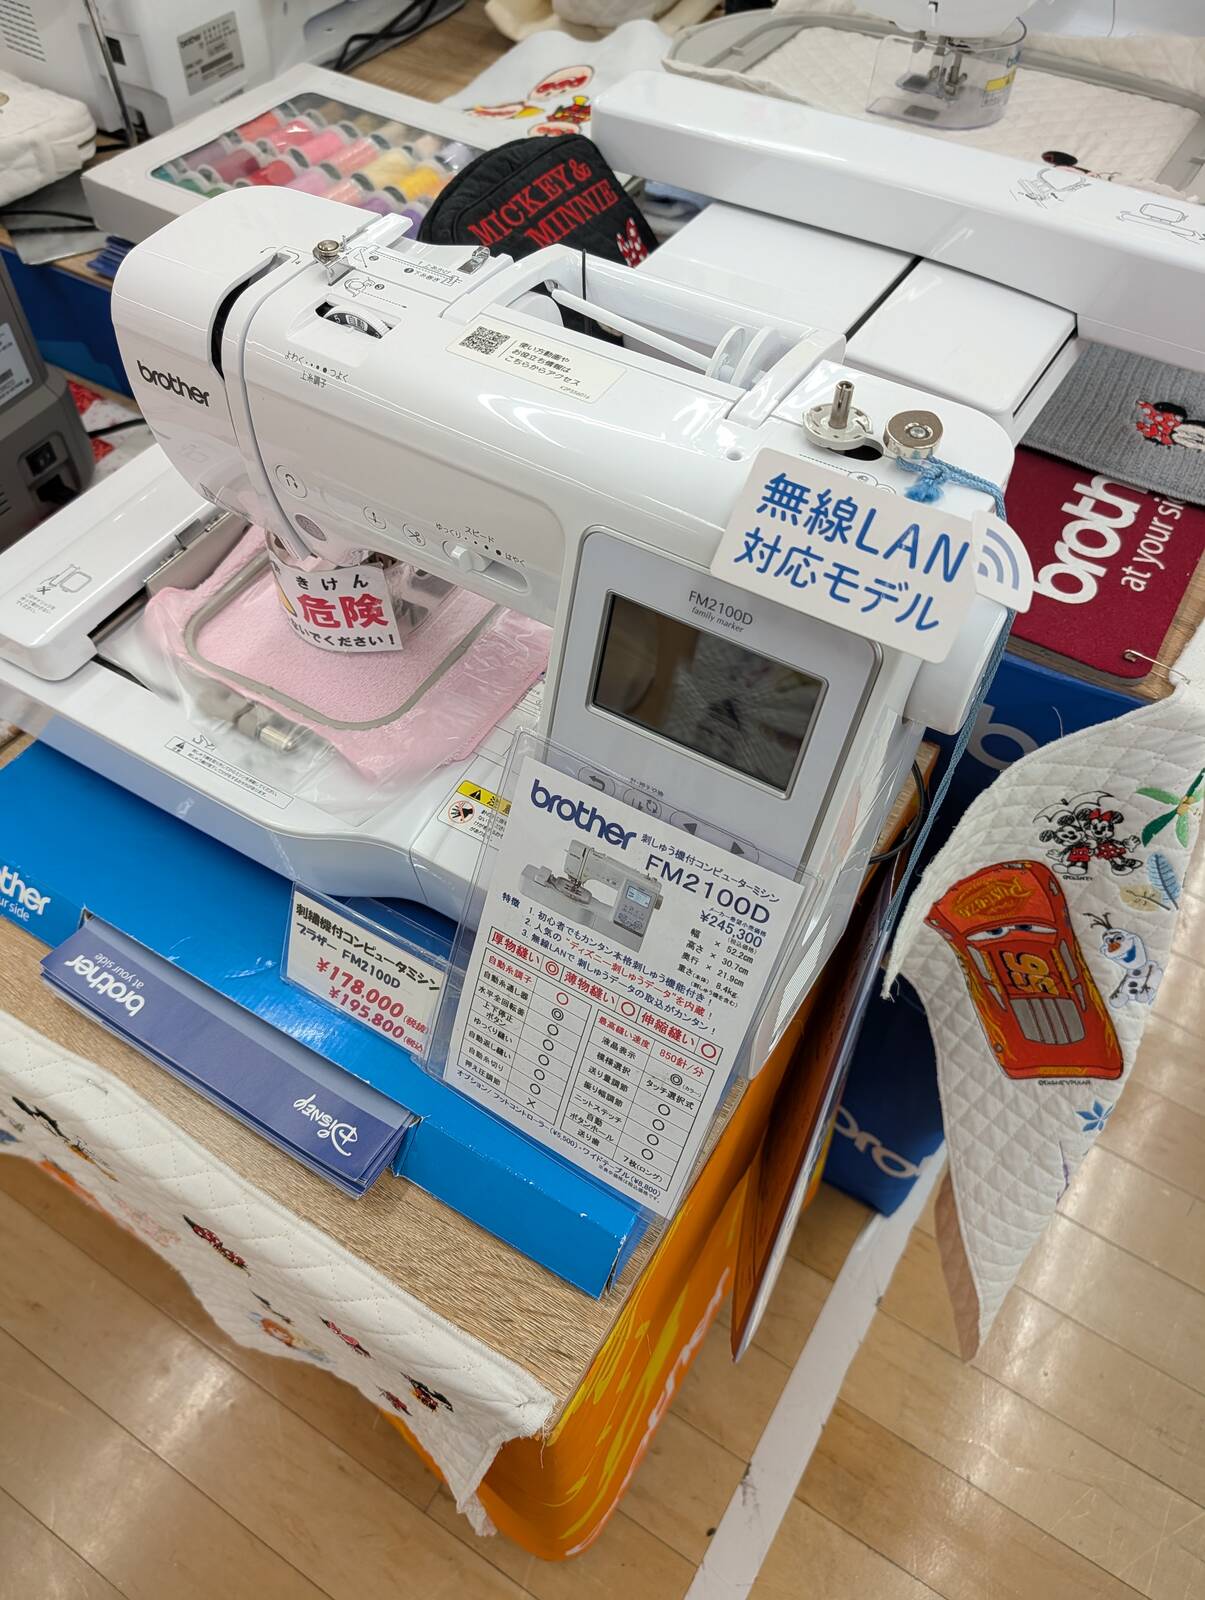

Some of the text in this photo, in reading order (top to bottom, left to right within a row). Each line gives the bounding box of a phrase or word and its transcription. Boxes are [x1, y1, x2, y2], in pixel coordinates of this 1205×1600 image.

[467, 158, 592, 246] MICKEY &
[523, 179, 619, 248] MINNIE
[284, 351, 349, 382] よわく つよく
[511, 349, 571, 374] お役立ち情報は
[519, 342, 570, 363] 使い方動画や
[136, 360, 210, 407] brother
[300, 370, 327, 388] 上糸調子
[504, 356, 582, 386] こちらからアクセス
[465, 526, 496, 543] スピード
[757, 472, 970, 583] 無線LAN
[1132, 516, 1174, 570] your
[435, 522, 526, 567] ゆっくり はやく
[733, 528, 940, 631] 対応モデル
[1121, 566, 1151, 592] at
[297, 593, 389, 629] 危険
[689, 590, 753, 625] FM2100D
[692, 607, 744, 632] family marker
[530, 779, 636, 849] brother
[640, 833, 779, 902] 刺しゅう機付コンピューターミシン
[0, 865, 51, 915] ther
[501, 891, 520, 908] 特徴
[645, 853, 769, 923] FM2100D
[9, 903, 30, 922] side
[699, 909, 762, 947] ¥245,300
[295, 903, 439, 990] 刺繍機付コンピュータミシン
[491, 930, 539, 963] 厚物縫い
[685, 939, 703, 954] 高さ
[721, 957, 749, 975] 30.7cm
[689, 927, 701, 939] 幅
[725, 945, 753, 964] 52.2cm
[94, 953, 144, 989] at your side
[341, 948, 400, 988] FM2100D
[488, 955, 532, 983] 自動糸調子
[680, 951, 698, 965] 奥行
[716, 969, 744, 987] 21.9cm
[64, 954, 145, 1017] brother
[483, 970, 528, 1000] 自動糸通し器
[563, 970, 614, 1004] 薄物縫い
[715, 981, 737, 998] 8.4kg
[482, 1001, 513, 1023] 上下停止
[485, 1011, 506, 1026] ボタン
[473, 1016, 512, 1043] ゆっくり縫い
[598, 1015, 650, 1049] 最高縫い速度
[641, 1011, 694, 1045] 伸縮縫い
[468, 1030, 511, 1059] 自動返し縫い
[468, 1046, 503, 1071] 自動糸切り
[601, 1035, 636, 1059] 液晶表示
[596, 1051, 631, 1076] 模様選択
[659, 1048, 704, 1077] 850針/分
[583, 1080, 623, 1107] 振り幅調節
[587, 1065, 628, 1092] 送り量調節
[574, 1093, 622, 1123] ニットステッチ
[645, 1079, 694, 1110] タッチ選択式
[293, 1093, 358, 1156] Disney
[569, 1112, 614, 1141] ボタンホール
[586, 1112, 602, 1127] 自動
[576, 1128, 600, 1146] 送り歯
